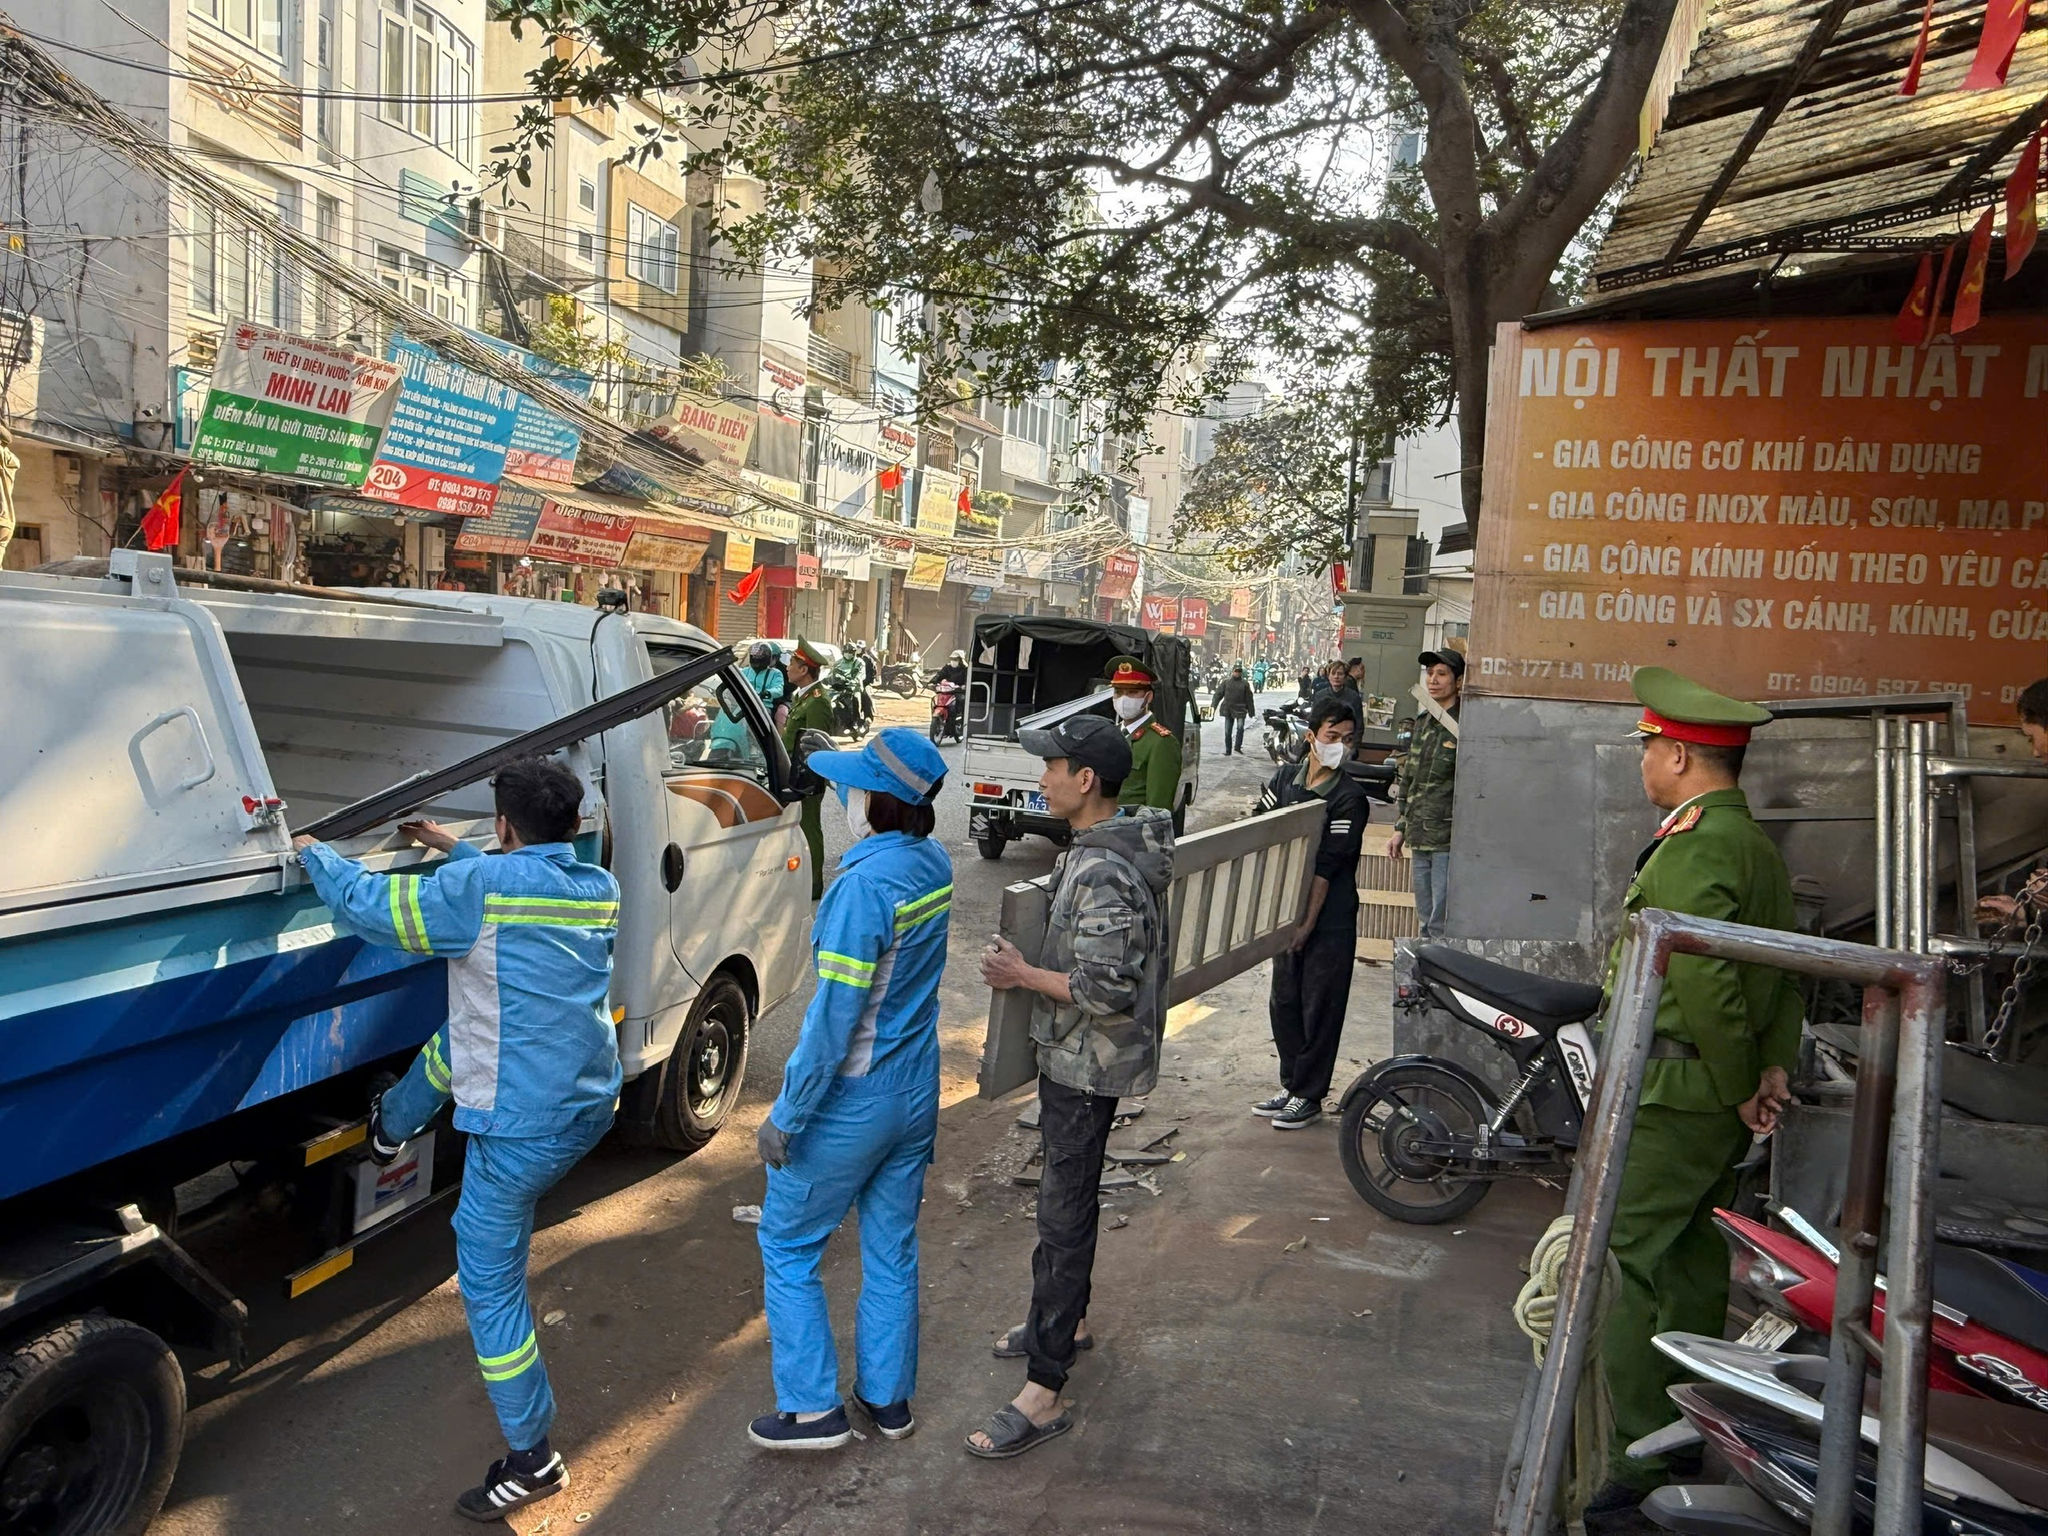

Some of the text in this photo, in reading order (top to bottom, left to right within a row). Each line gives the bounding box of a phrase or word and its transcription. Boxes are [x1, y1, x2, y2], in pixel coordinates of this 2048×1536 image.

[262, 346, 290, 365] THIẾT
[290, 354, 301, 372] BỊ
[302, 356, 325, 376] ĐIỆN
[325, 362, 351, 382] NƯỚC
[1520, 337, 1620, 410] NỘI
[1644, 329, 1799, 398] THẤT
[1821, 334, 2001, 412] NHẬT
[265, 372, 353, 415] MINH LAN
[213, 401, 243, 424] ĐIỂM
[266, 414, 280, 432] VÀ
[280, 417, 302, 435] GIỚI
[302, 423, 328, 442] THIỆU
[328, 425, 348, 445] SẢN
[373, 466, 402, 487] 204
[1553, 434, 1983, 480] GIA CÔNG CƠ KHÍ DÂN DỤNG
[1548, 490, 1596, 521] GIA
[1604, 486, 1687, 523] CÔNG
[1695, 494, 1768, 526] INOX
[1777, 492, 1858, 529] MÀU,
[1868, 494, 1946, 532] SƠN,
[1956, 497, 2011, 537] MẠ
[1542, 543, 1590, 573] GIA
[1599, 539, 1682, 577] CÔNG
[1689, 542, 1766, 580] KÍNH
[1773, 540, 1844, 581] UỐN
[1849, 551, 1929, 585] THEO
[1940, 550, 2001, 588] YÊU
[1538, 590, 1586, 620] GIA
[1595, 586, 1677, 625] CÔNG
[1686, 590, 1724, 626] VÀ
[1732, 599, 1772, 629] SX
[1783, 594, 1877, 637] CÁNH,
[1888, 600, 1977, 641] KÍNH,
[1480, 656, 1513, 676] ĐC:
[1520, 659, 1552, 679] 177
[1560, 661, 1584, 680] LA
[1767, 672, 1801, 692] ĐT:
[1809, 674, 1867, 696] 0904
